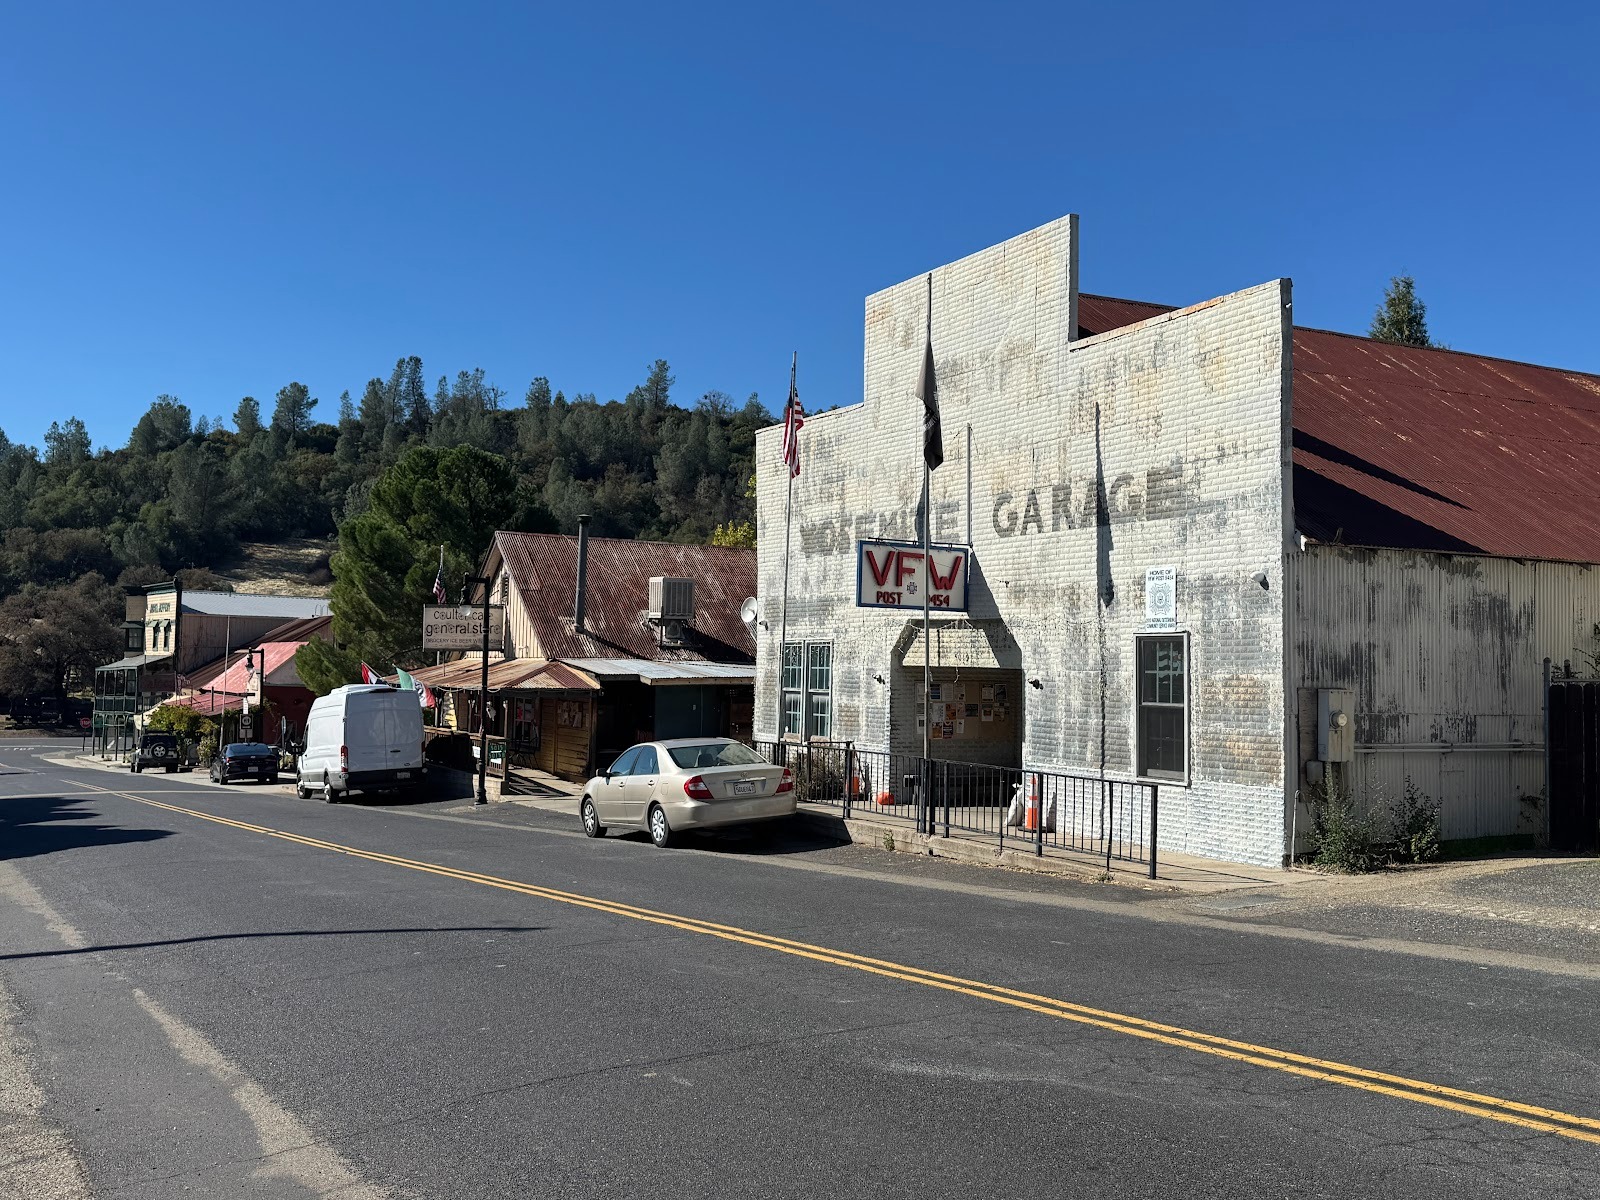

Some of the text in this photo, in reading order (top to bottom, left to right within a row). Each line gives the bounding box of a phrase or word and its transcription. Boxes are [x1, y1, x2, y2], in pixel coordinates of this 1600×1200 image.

[992, 464, 1184, 539] GARAGE
[866, 550, 963, 590] VFW
[876, 591, 950, 607] POST 454
[472, 611, 493, 620] cae
[472, 622, 502, 634] stre
